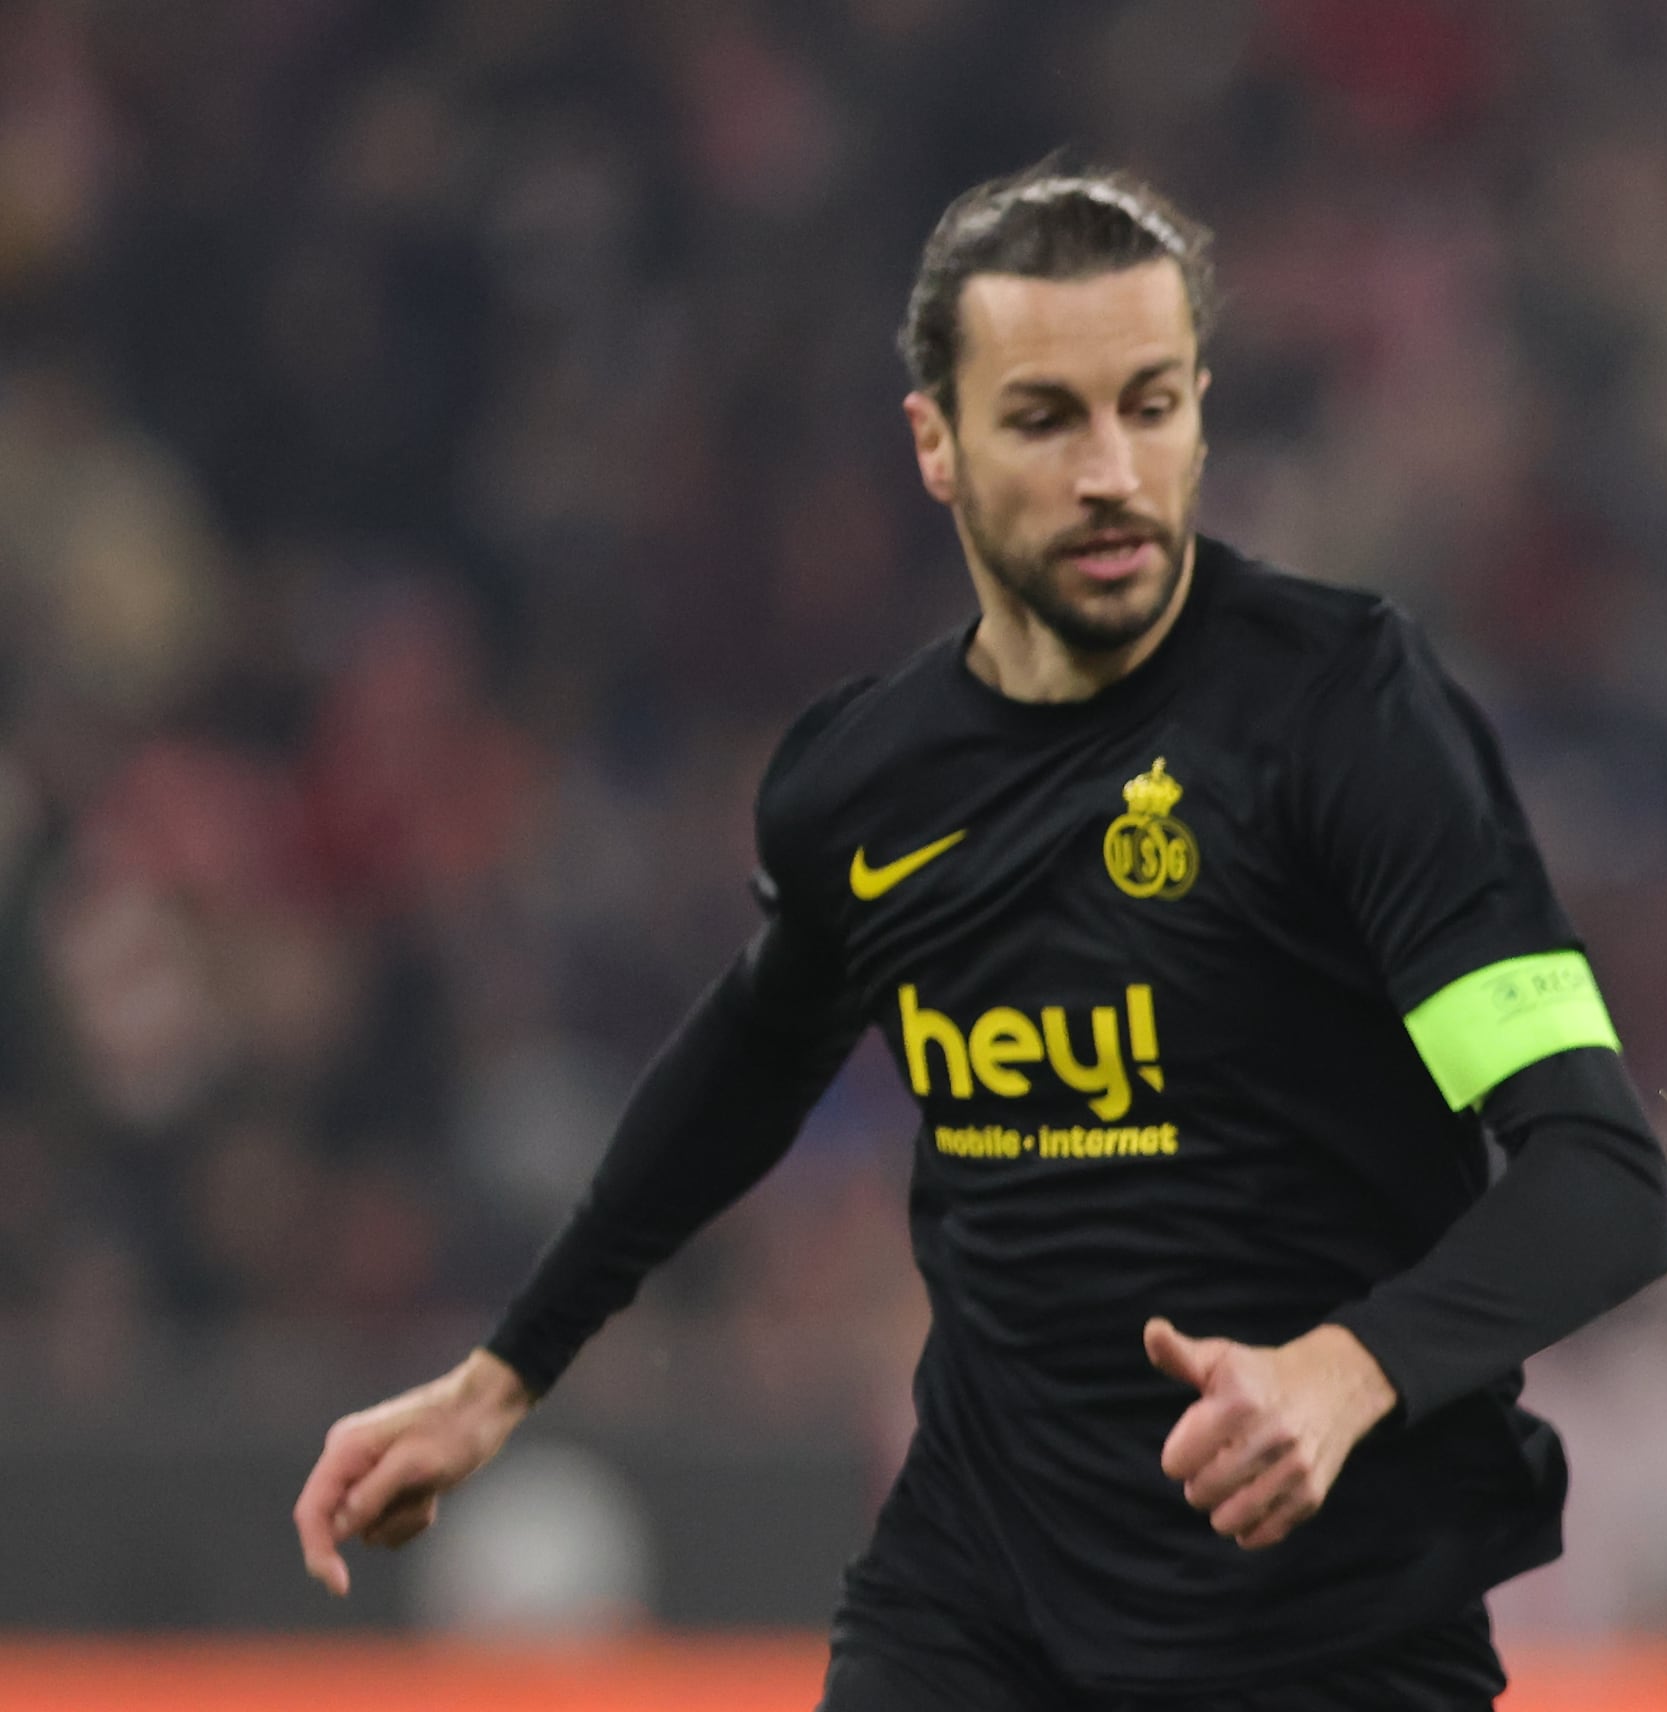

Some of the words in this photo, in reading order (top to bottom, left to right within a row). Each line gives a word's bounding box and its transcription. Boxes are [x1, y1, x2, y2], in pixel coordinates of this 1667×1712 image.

[898, 983, 1165, 1122] hey!
[935, 1124, 1021, 1159] mobile
[1038, 1122, 1179, 1159] internet
